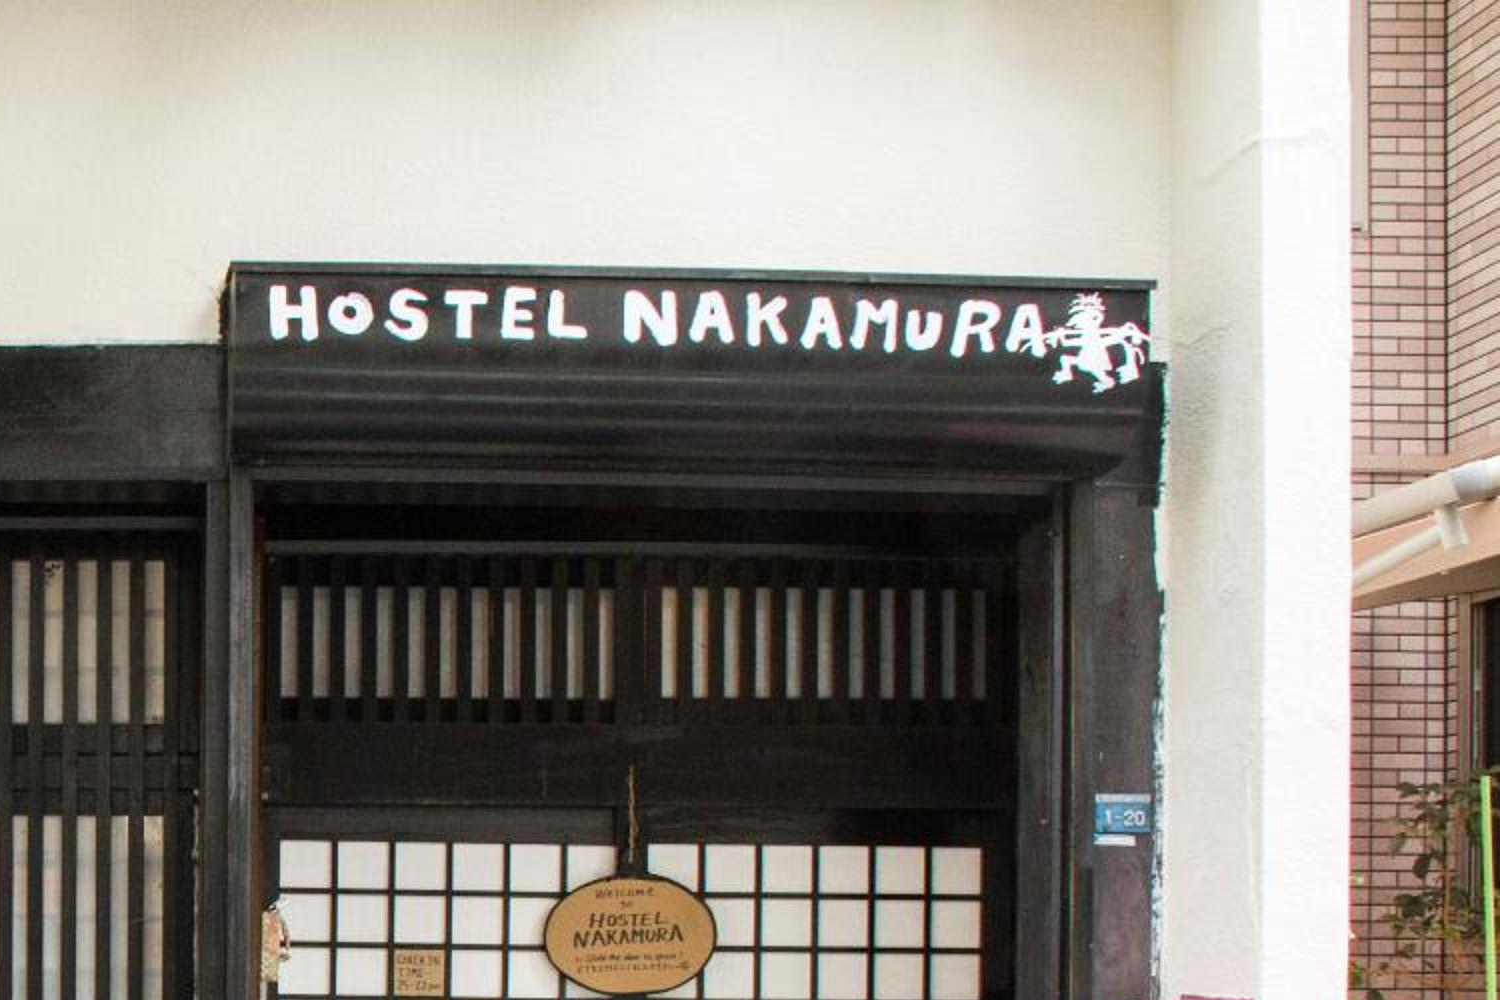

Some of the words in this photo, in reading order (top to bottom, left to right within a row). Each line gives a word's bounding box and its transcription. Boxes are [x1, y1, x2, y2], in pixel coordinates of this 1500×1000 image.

[269, 284, 588, 342] HOSTEL
[622, 290, 1051, 359] NAKAMURA
[1105, 809, 1146, 827] 1-20
[589, 911, 670, 928] HOSTEL
[573, 924, 684, 948] NAKAMURA
